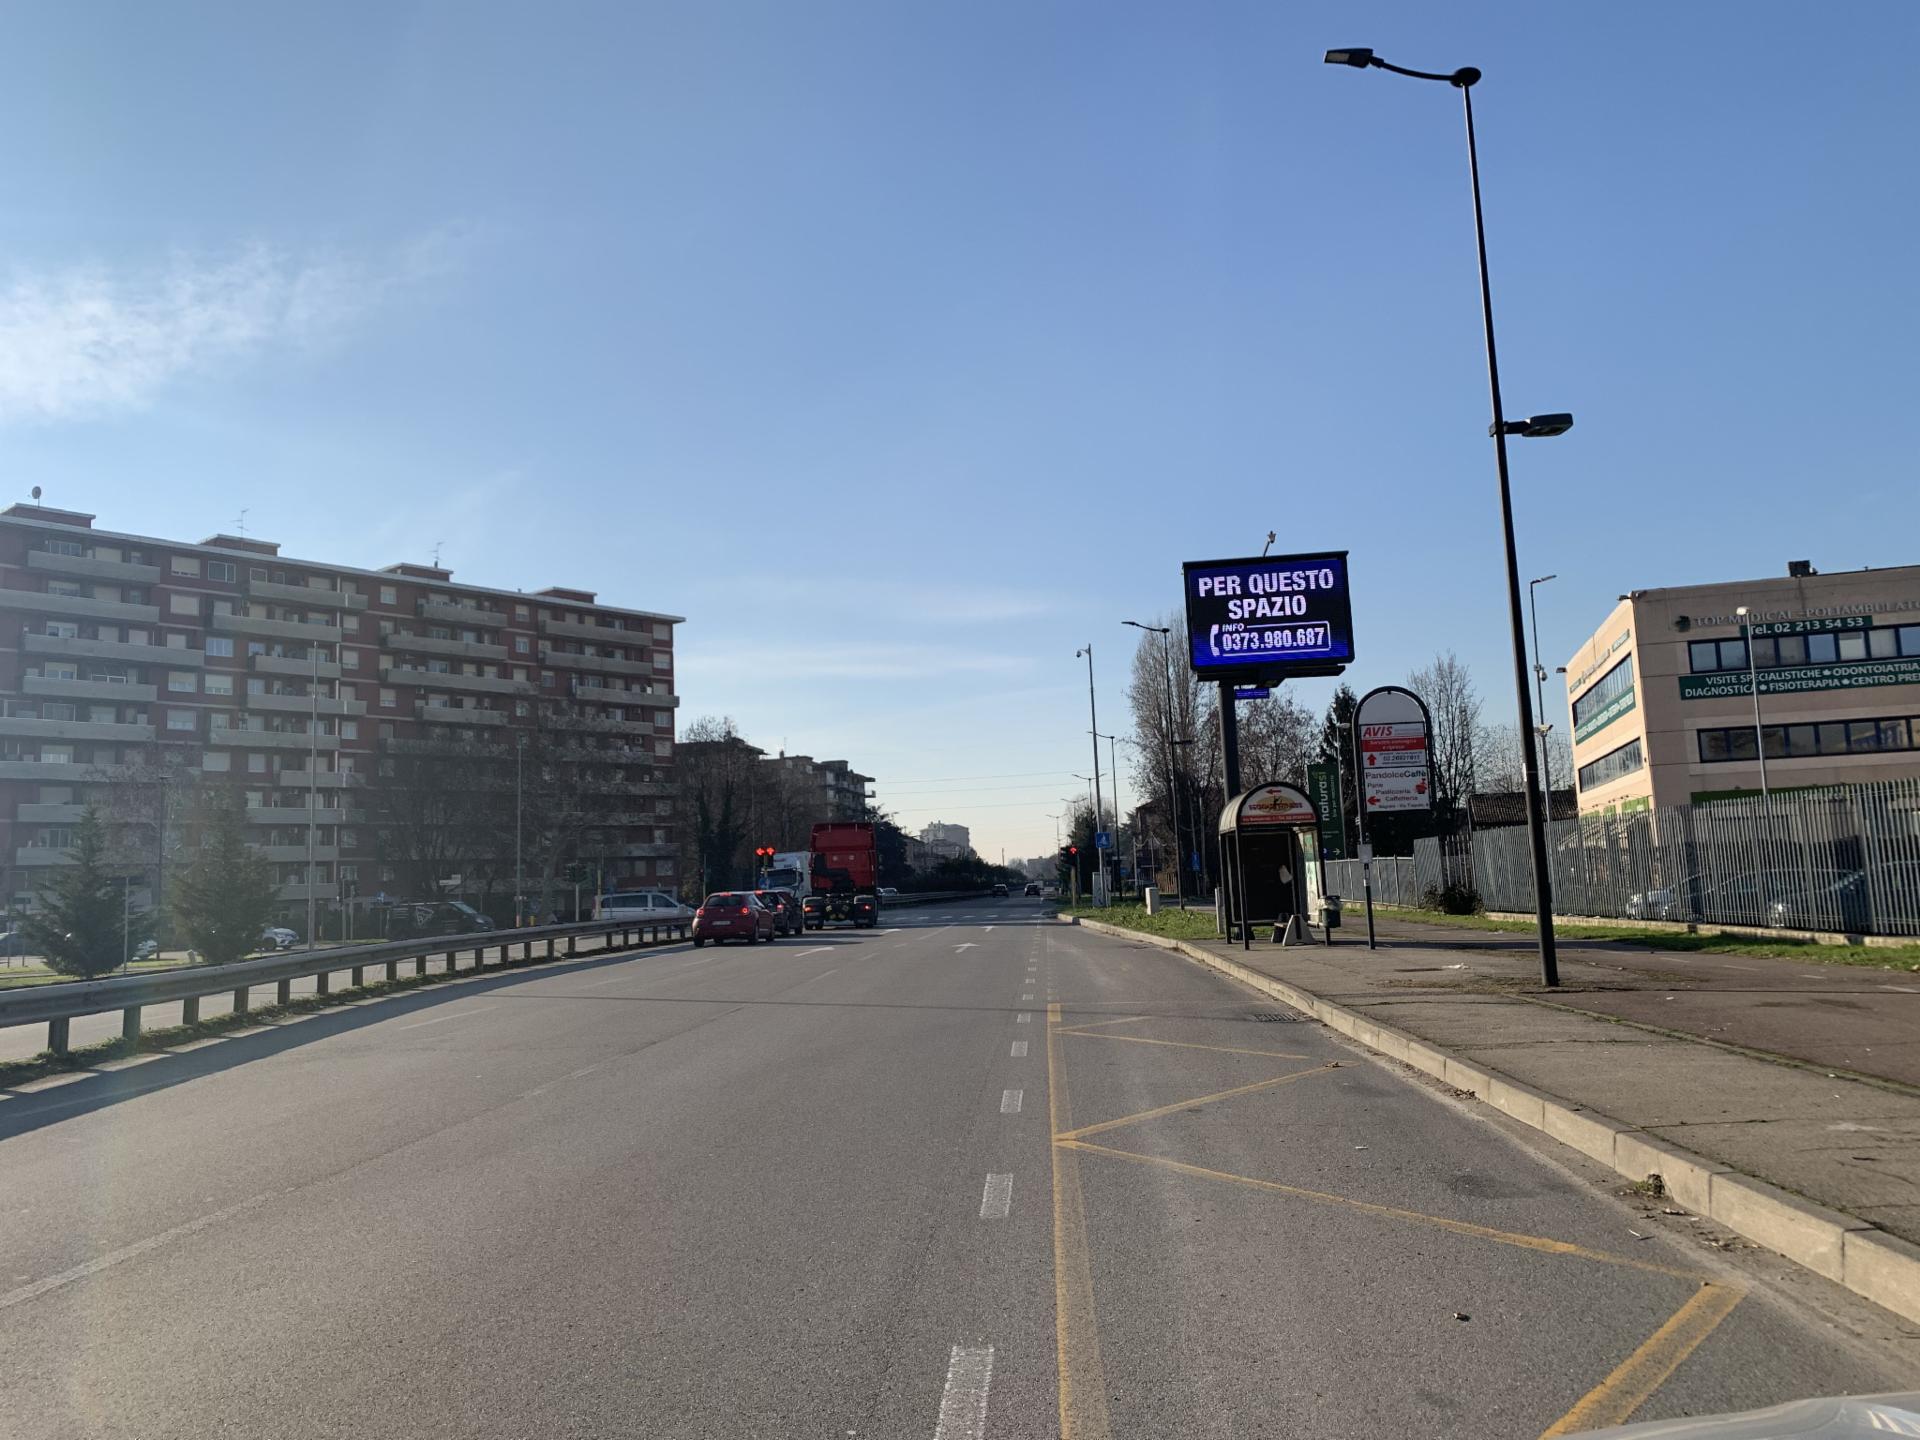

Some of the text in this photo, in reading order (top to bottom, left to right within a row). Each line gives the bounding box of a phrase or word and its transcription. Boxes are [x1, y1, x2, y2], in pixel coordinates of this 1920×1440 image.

[1198, 568, 1334, 597] PER QUESTO
[1228, 595, 1307, 620] SPAZIO
[1222, 623, 1245, 632] INFO
[1696, 615, 1726, 627] TOP
[1774, 623, 1791, 634] 02
[1796, 621, 1820, 631] 213
[1825, 618, 1842, 629] 54
[1847, 617, 1864, 627] 53
[1223, 628, 1324, 650] 0373.980.687
[1685, 685, 1754, 697] DIAGNOSTICA
[1770, 680, 1840, 691] FISIOTERAPIA
[1852, 675, 1895, 685] CENTRO
[1706, 676, 1737, 685] VISITE
[1740, 670, 1821, 683] SPECIALISTICHE
[1364, 727, 1392, 737] AVIS
